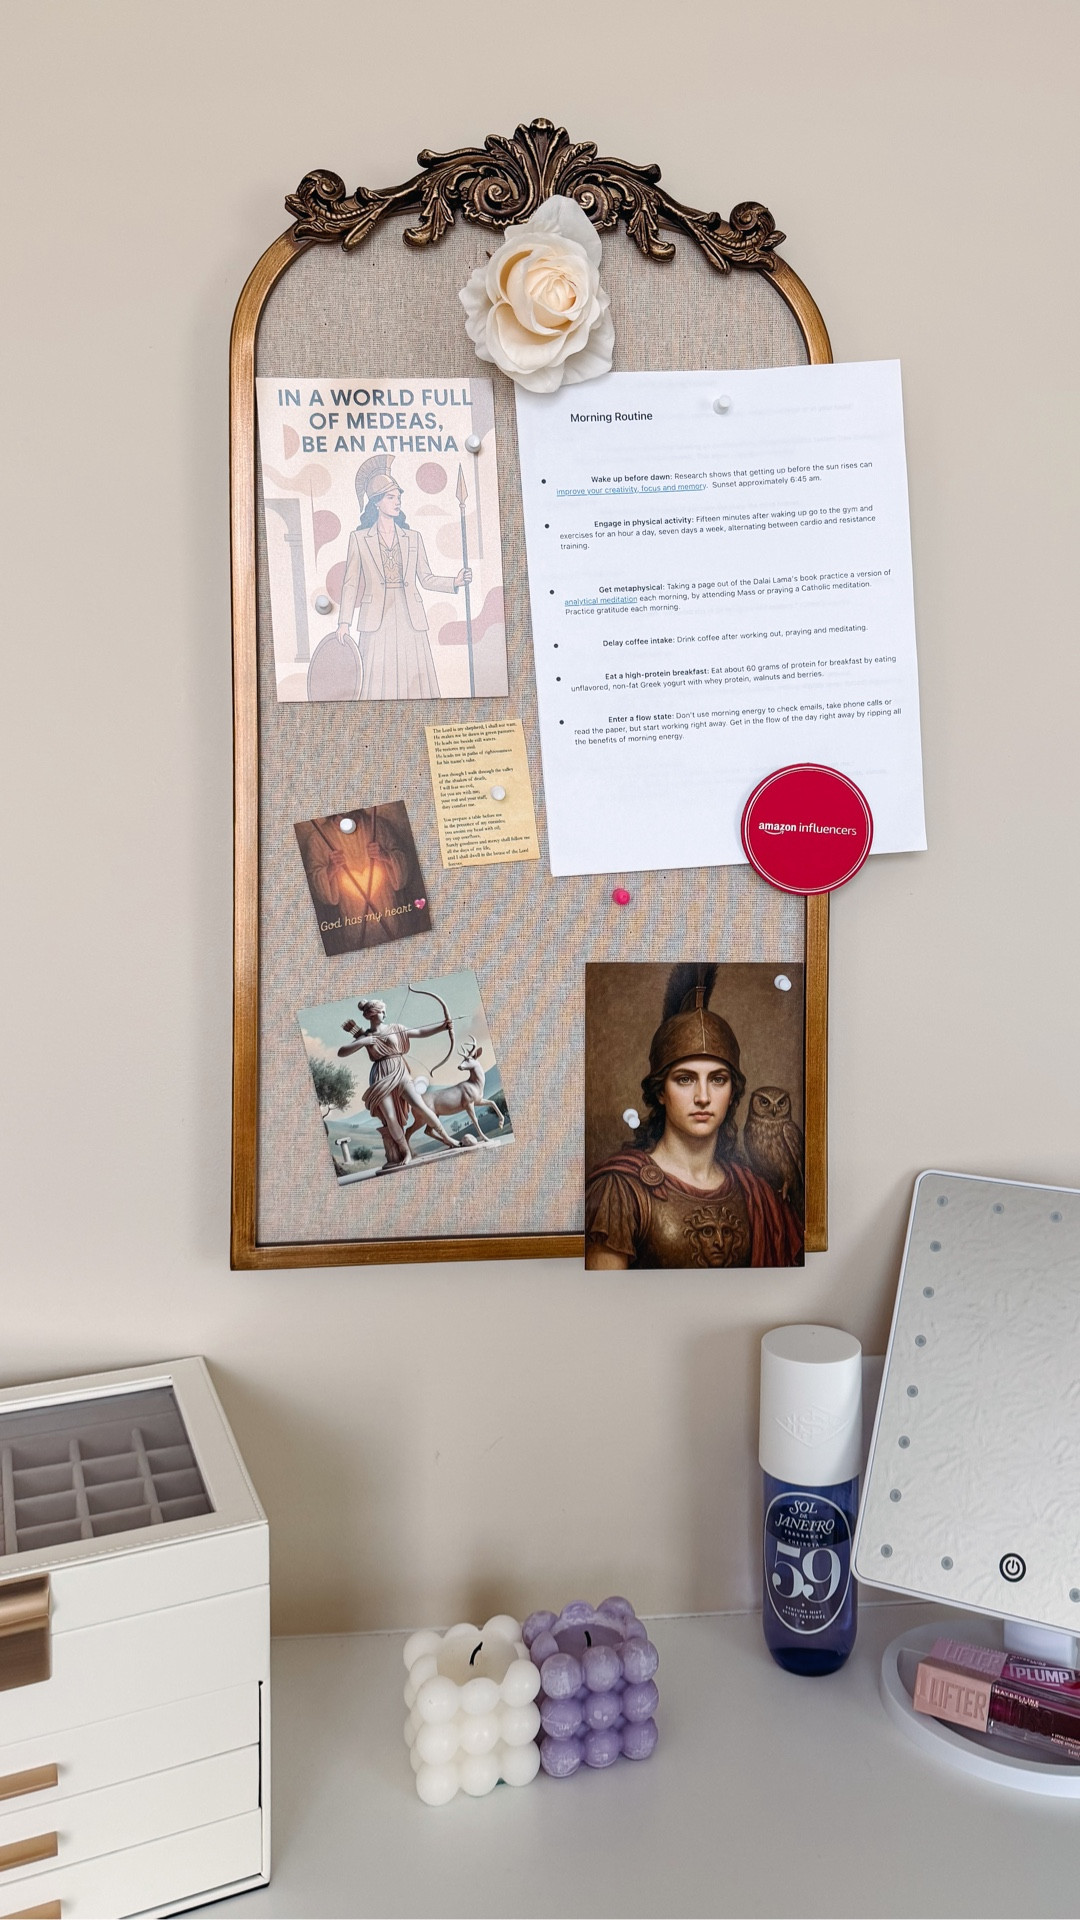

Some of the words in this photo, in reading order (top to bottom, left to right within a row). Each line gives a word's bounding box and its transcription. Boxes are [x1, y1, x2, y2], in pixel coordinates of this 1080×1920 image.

[278, 389, 301, 406] IN
[309, 389, 325, 406] A
[331, 389, 414, 406] WORLD
[423, 389, 473, 405] FULL
[309, 413, 338, 429] OF
[347, 413, 443, 432] MEDEAS,
[570, 412, 612, 424] Morning
[614, 411, 653, 421] Routine
[302, 436, 327, 452] BE
[335, 436, 365, 452] AN
[373, 436, 459, 452] ATHENA
[590, 475, 612, 483] Wake
[624, 474, 649, 482] before
[650, 473, 672, 481] dawn:
[674, 471, 708, 480] Research
[733, 469, 747, 477] that
[749, 468, 775, 477] getting
[787, 465, 811, 473] before
[812, 464, 825, 472] the
[556, 488, 585, 498] improve
[587, 488, 604, 496] your
[604, 485, 640, 496] creativity,
[640, 484, 662, 494] focus
[662, 484, 677, 493] and
[676, 483, 708, 492] memory.
[711, 480, 737, 489] Sunset
[738, 476, 789, 488] approximately
[789, 475, 807, 484] 6:45
[593, 520, 622, 529] Engage
[631, 517, 663, 527] physical
[664, 516, 694, 525] activity:
[695, 515, 721, 523] Fifteen
[752, 512, 769, 520] after
[770, 510, 796, 518] waking
[808, 509, 818, 517] go
[828, 506, 841, 514] the
[842, 506, 858, 514] gym
[859, 504, 873, 512] and
[560, 543, 590, 551] training.
[598, 586, 612, 594] Get
[613, 583, 665, 593] metaphysical:
[666, 582, 690, 591] Taking
[697, 582, 716, 590] page
[716, 580, 729, 588] out
[730, 579, 738, 587] of
[739, 578, 752, 586] the
[753, 577, 771, 585] Dalai
[772, 575, 798, 584] Lama's
[799, 573, 818, 582] book
[819, 572, 849, 581] practice
[856, 570, 882, 578] version
[883, 568, 891, 576] of
[596, 606, 629, 616] gratitude
[630, 605, 648, 613] each
[649, 603, 680, 612] morning.
[602, 639, 624, 648] Delay
[624, 638, 649, 646] coffee
[650, 636, 675, 644] intake:
[676, 635, 696, 643] Drink
[697, 634, 720, 642] coffee
[739, 631, 768, 639] working
[785, 628, 812, 637] praying
[813, 626, 827, 634] and
[828, 624, 868, 633] meditating.
[570, 683, 611, 692] unflavored,
[612, 681, 639, 690] non-fat
[639, 680, 662, 689] Greek
[662, 679, 686, 688] yogurt
[687, 678, 703, 686] with
[704, 677, 723, 685] whey
[724, 675, 751, 684] protein,
[753, 673, 781, 682] walnuts
[781, 672, 796, 680] and
[796, 670, 824, 679] berries.
[635, 714, 652, 722] flow
[653, 713, 674, 721] state:
[741, 708, 766, 716] energy
[776, 704, 798, 713] check
[799, 703, 825, 711] emails,
[843, 701, 865, 709] phone
[866, 699, 883, 707] calls
[574, 738, 587, 746] the
[588, 736, 617, 745] benefits
[618, 735, 626, 743] of
[759, 822, 796, 832] amazon
[799, 823, 856, 835] influencers
[320, 918, 342, 931] God
[344, 914, 362, 927] has
[364, 912, 382, 922] my
[385, 903, 412, 917] heart
[789, 1500, 817, 1514] SOL
[775, 1513, 834, 1535] JANEIRO
[785, 1530, 823, 1539] FRAGRANCE
[772, 1541, 841, 1603] 59
[1015, 1667, 1070, 1684] PLUMP
[928, 1677, 987, 1721] LIFTER
[994, 1687, 1040, 1705] MAYBELLINE
